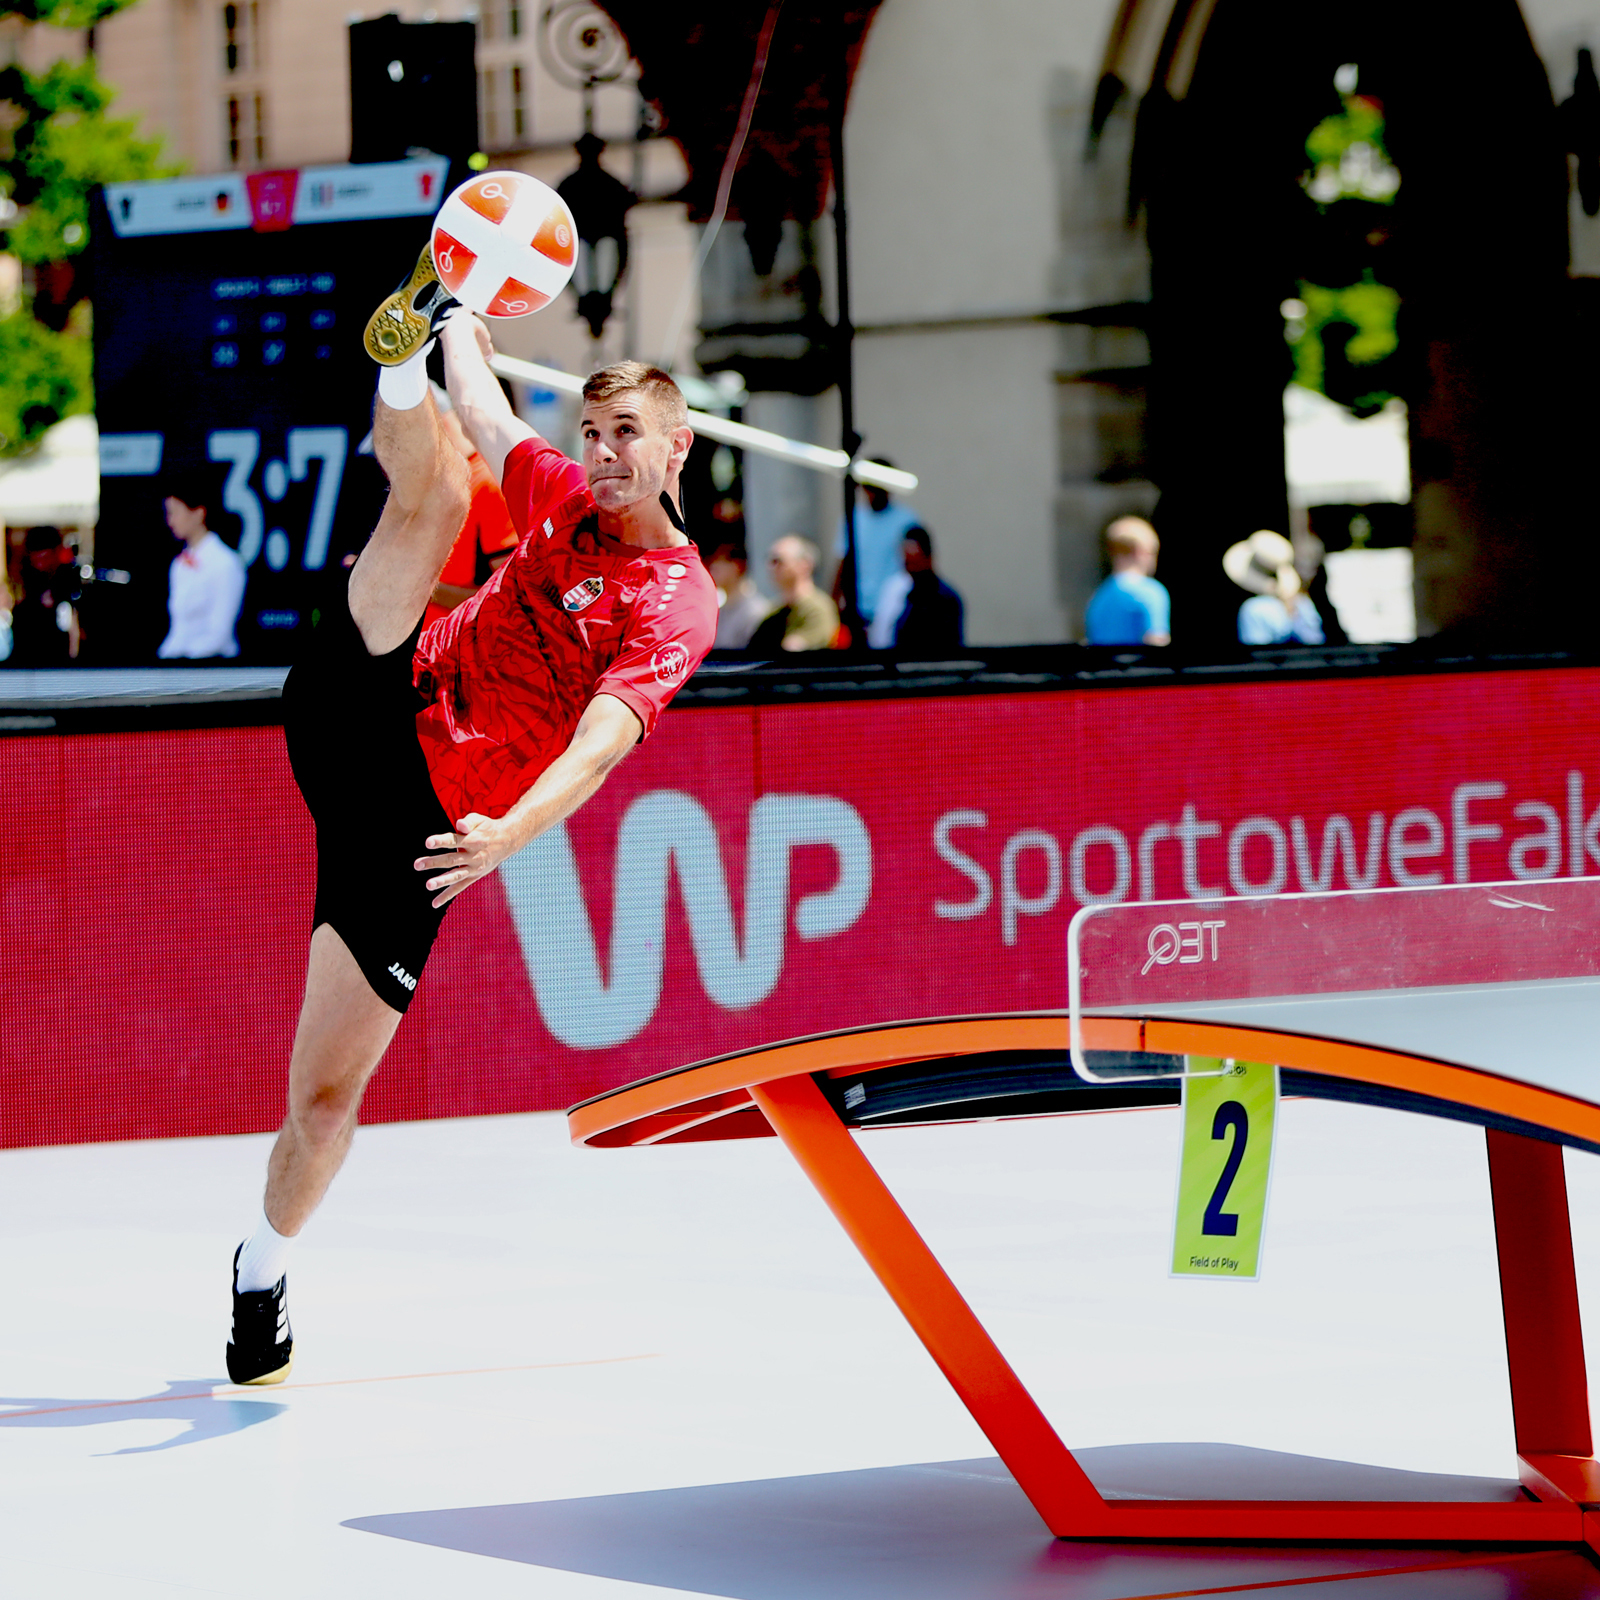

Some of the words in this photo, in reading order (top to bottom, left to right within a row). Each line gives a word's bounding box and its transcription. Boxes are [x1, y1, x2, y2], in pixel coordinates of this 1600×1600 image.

[207, 426, 348, 569] 3:7
[387, 961, 418, 991] JAKO
[500, 789, 872, 1050] WP
[1202, 1100, 1249, 1236] 2
[1189, 1255, 1210, 1268] Field
[1210, 1256, 1220, 1268] of
[1221, 1257, 1239, 1272] Play
